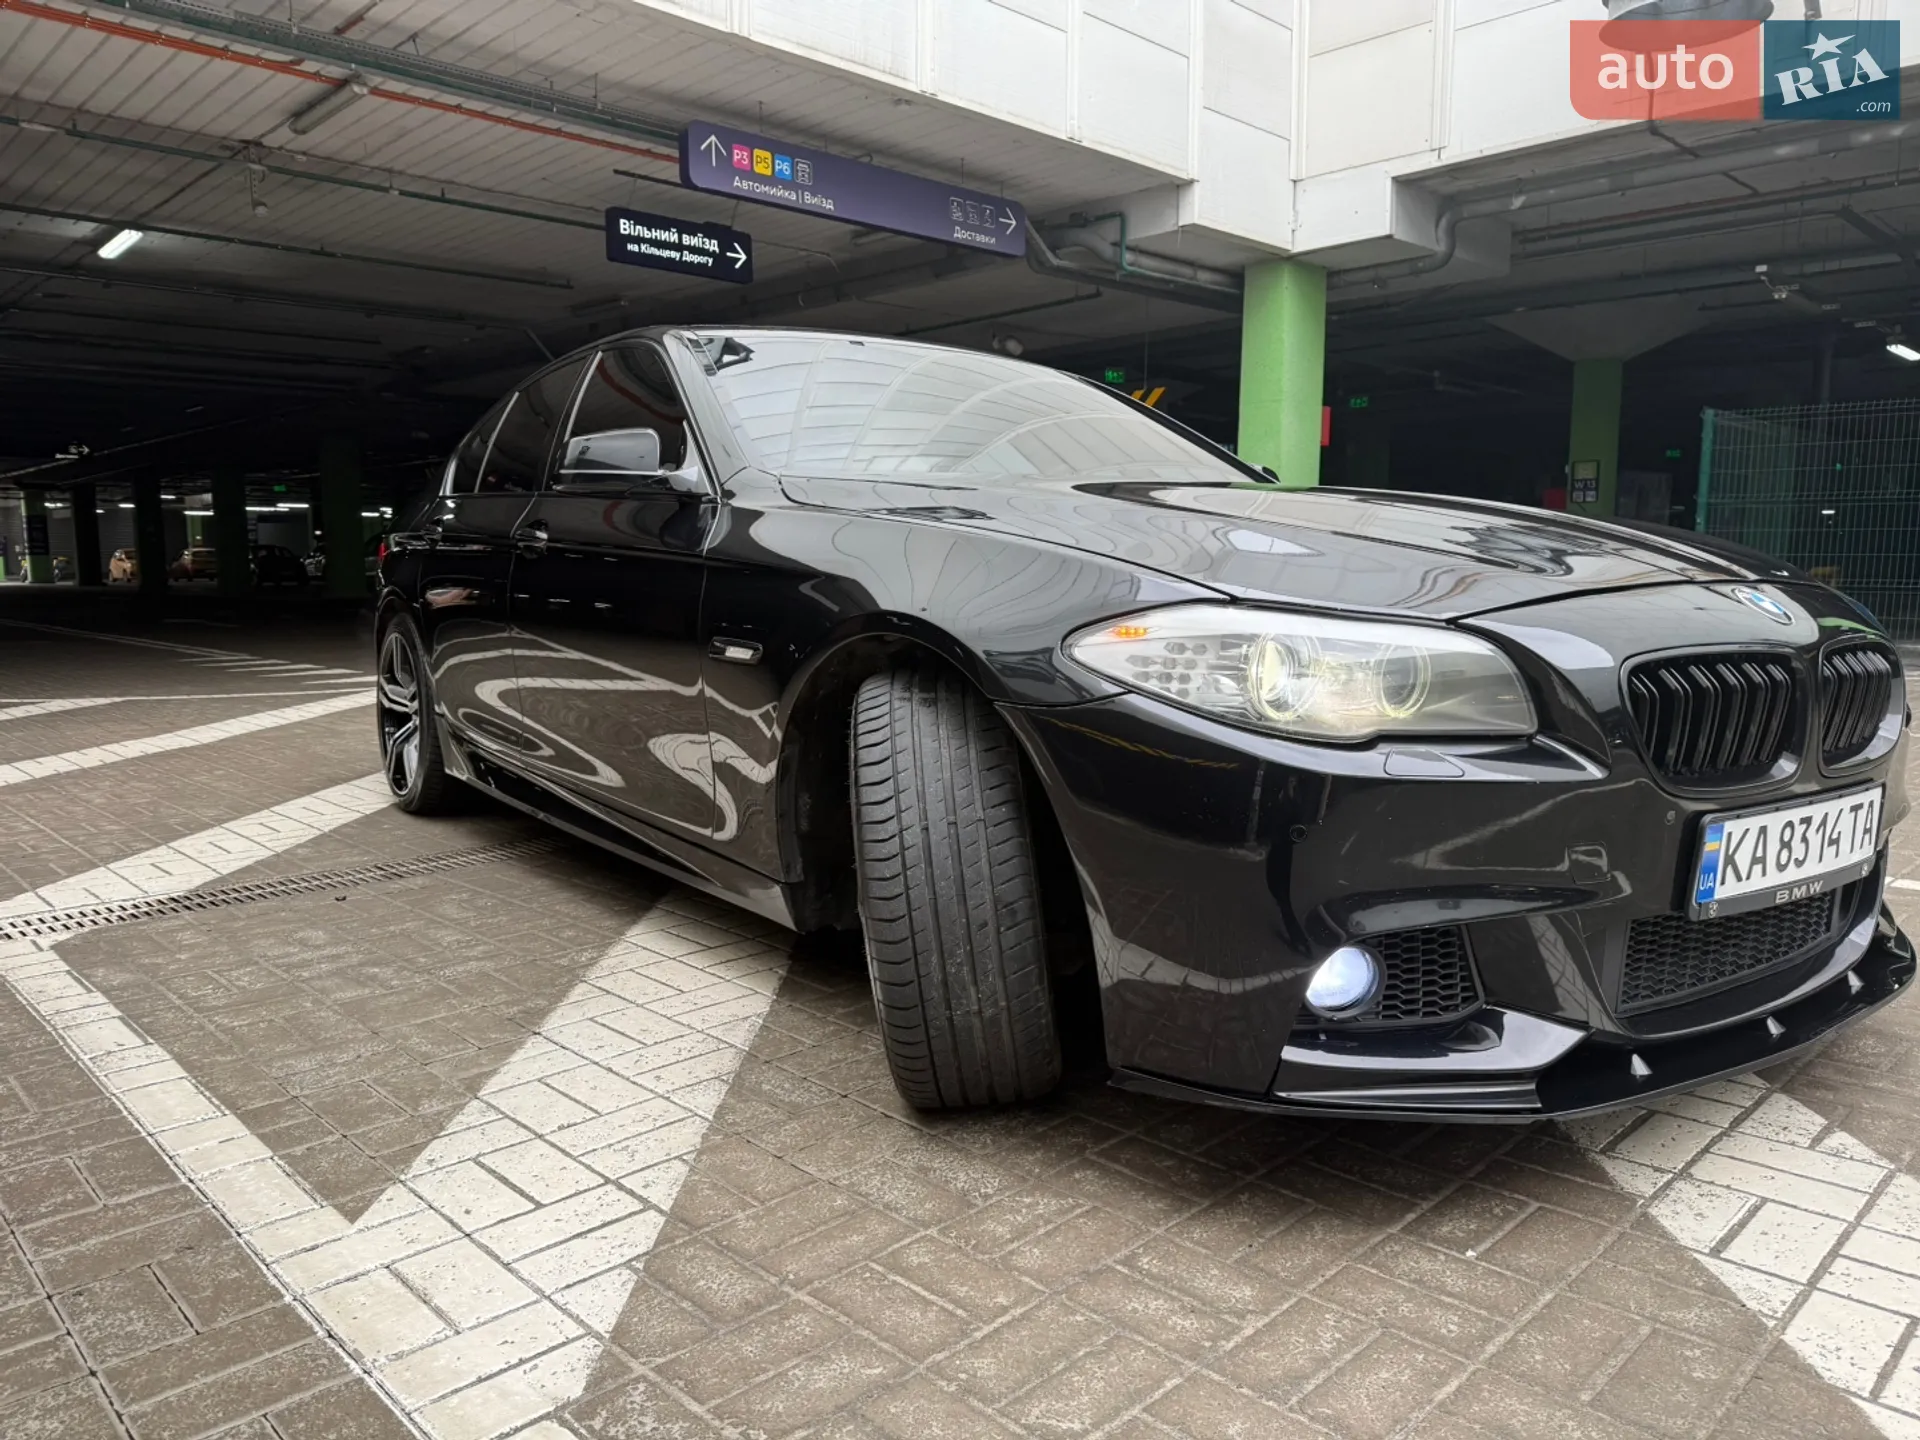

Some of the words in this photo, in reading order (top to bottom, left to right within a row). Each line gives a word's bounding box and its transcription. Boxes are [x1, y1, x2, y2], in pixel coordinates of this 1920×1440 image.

[733, 149, 749, 164] P3
[755, 155, 770, 170] P5
[775, 160, 790, 175] P6
[733, 176, 796, 200] Автомийка
[804, 191, 835, 211] Виїзд
[619, 218, 679, 244] Вільний
[682, 233, 719, 254] виїзд
[955, 227, 996, 245] Доставки
[627, 242, 639, 253] на
[640, 244, 681, 261] Кільцеву
[682, 251, 714, 267] Дорогу
[1699, 873, 1715, 890] UA
[1774, 880, 1824, 904] BMW
